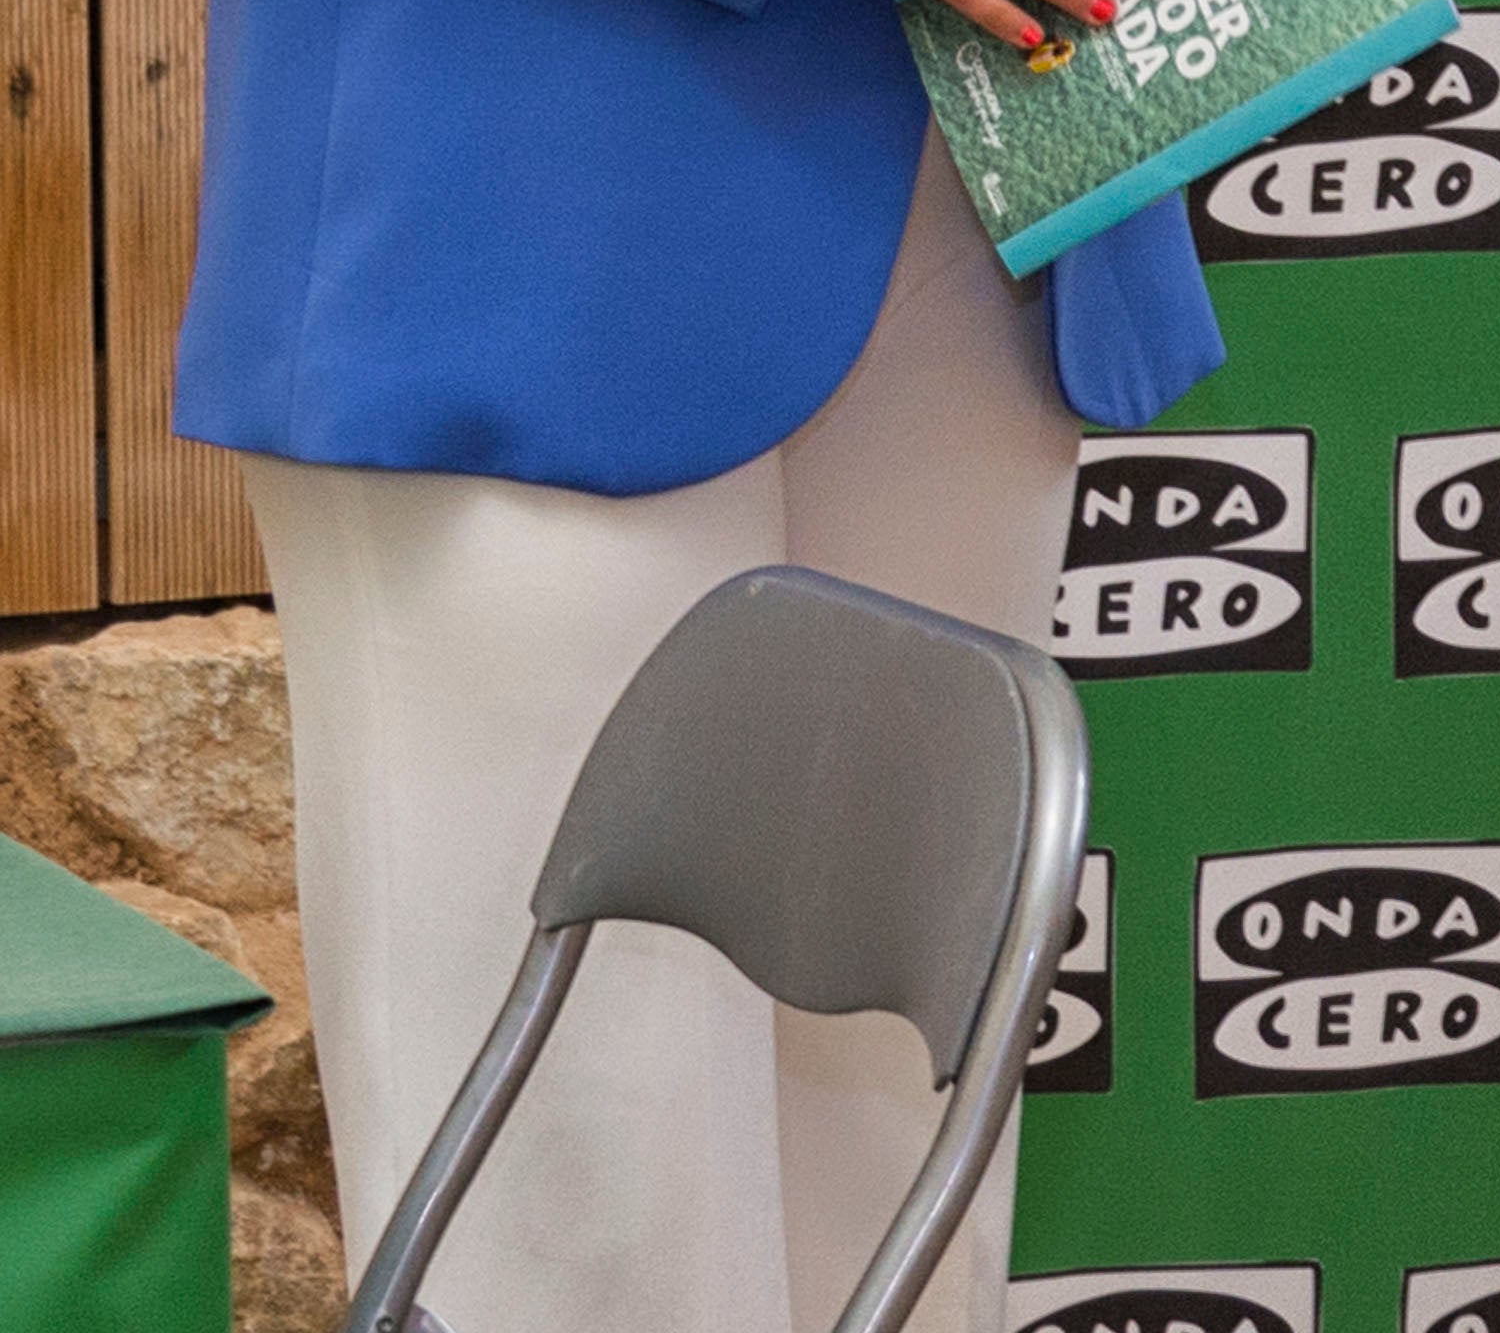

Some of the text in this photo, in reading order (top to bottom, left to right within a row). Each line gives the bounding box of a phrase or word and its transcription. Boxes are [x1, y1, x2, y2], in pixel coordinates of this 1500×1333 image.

[1174, 35, 1218, 81] O
[1336, 62, 1474, 107] DA
[1251, 159, 1471, 215] CERO
[1082, 484, 1259, 528] NDA
[1243, 897, 1478, 950] ONDA
[1258, 992, 1478, 1049] CERO
